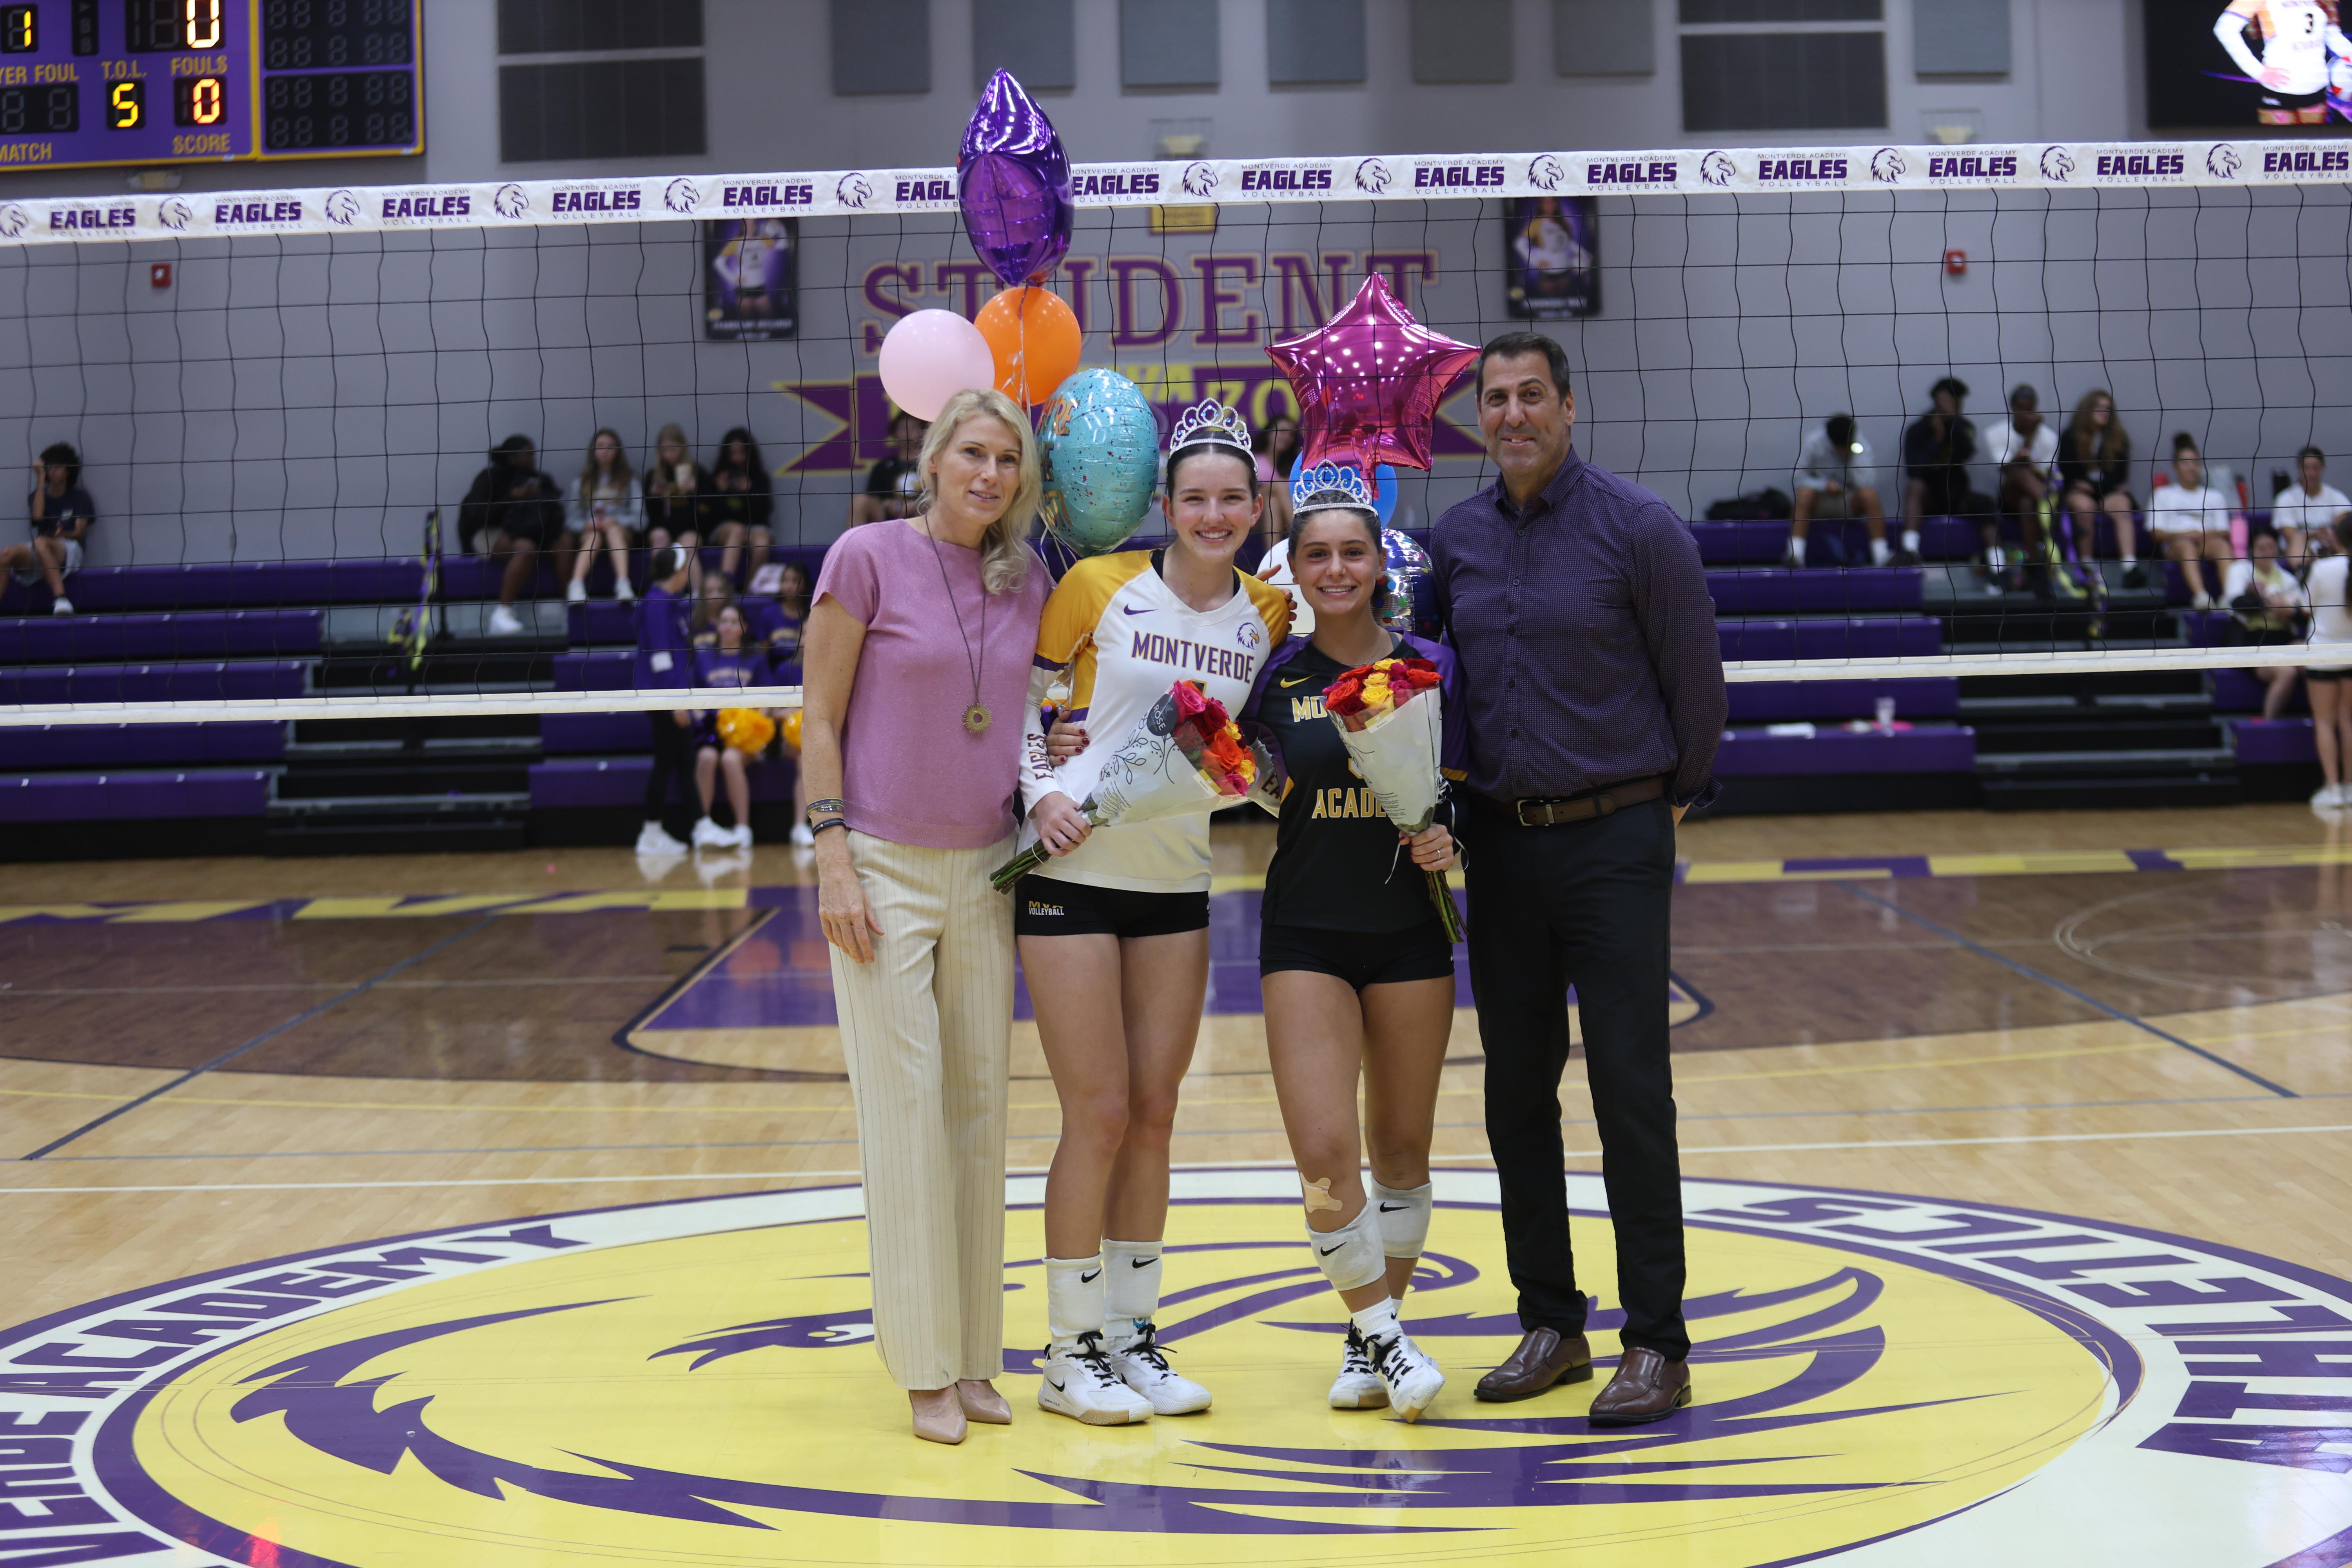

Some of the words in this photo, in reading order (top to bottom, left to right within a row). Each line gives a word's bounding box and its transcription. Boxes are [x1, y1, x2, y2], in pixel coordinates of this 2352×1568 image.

[0, 66, 27, 85] YER
[35, 63, 80, 83] FOUL
[101, 60, 147, 80] T.O.L.
[171, 55, 228, 76] FOULS
[113, 82, 138, 127] 5
[192, 78, 220, 124] 0
[172, 133, 230, 155] SCORE
[1759, 161, 1847, 179] EAGLES
[1929, 158, 2016, 176] EAGLES
[2097, 156, 2183, 174] EAGLES
[2264, 152, 2348, 171] EAGLES
[1242, 171, 1331, 189] EAGLES
[1415, 167, 1504, 187] EAGLES
[1588, 163, 1676, 183] EAGLES
[896, 181, 958, 201] EAGL
[1072, 175, 1158, 195] EAGLES
[553, 192, 640, 211] EAGLES
[724, 186, 812, 206] EAGLES
[216, 203, 301, 223] EAGLES
[383, 197, 469, 217] EAGLES
[724, 205, 814, 214] VOLLEYBALL
[50, 209, 135, 229] EAGLES
[1131, 630, 1255, 684] MONTVERDE
[1154, 704, 1166, 731] ROSE
[1027, 733, 1055, 781] EAGLES
[1312, 788, 1387, 818] ACAD
[0, 1224, 591, 1399] ACADEMY
